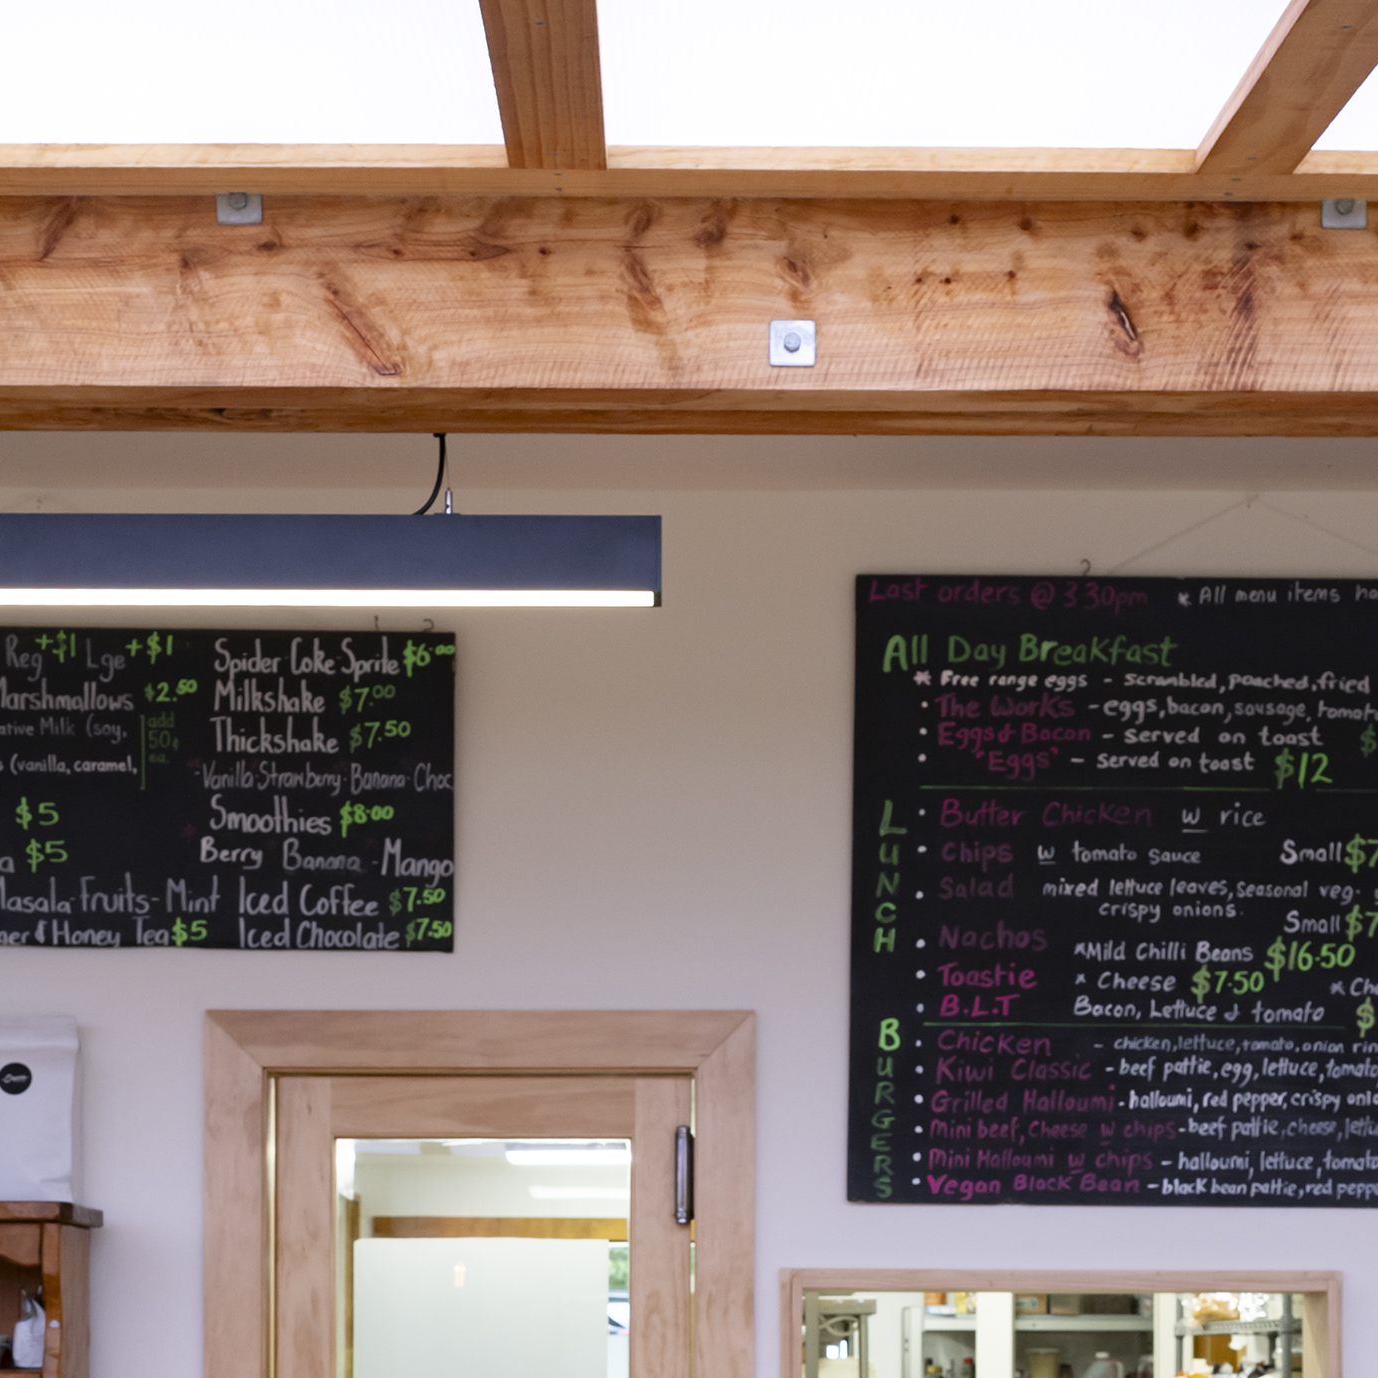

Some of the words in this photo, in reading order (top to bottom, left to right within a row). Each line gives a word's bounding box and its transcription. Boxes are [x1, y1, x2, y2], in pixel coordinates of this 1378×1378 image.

[1199, 585, 1226, 604] All
[1235, 588, 1277, 603] menu
[1287, 581, 1341, 603] items
[882, 633, 928, 673] All
[947, 635, 1007, 670] Day
[1019, 633, 1178, 667] Breakfast
[213, 676, 326, 713] Milkshake
[339, 685, 396, 715] $7.00
[934, 693, 981, 719] The
[209, 715, 340, 754] Thickshake
[350, 720, 411, 753] $7.50
[210, 793, 333, 835] Smoothies
[939, 799, 1028, 827] Butter
[1042, 802, 1152, 827] Chicken
[1219, 801, 1267, 827] rice
[941, 841, 1014, 873] Chips
[1072, 840, 1137, 864] tomato
[1149, 848, 1201, 864] sauce
[1280, 839, 1342, 865] Small
[239, 875, 289, 915] Iced
[299, 883, 380, 916] Coffee
[389, 886, 446, 916] $7.50
[1073, 995, 1142, 1020] Bacon,
[1149, 999, 1217, 1021] Lettuce
[1251, 1000, 1325, 1023] tomato
[927, 1173, 1002, 1201] Vegan
[1013, 1175, 1071, 1192] Black
[1079, 1173, 1140, 1192] Bean
